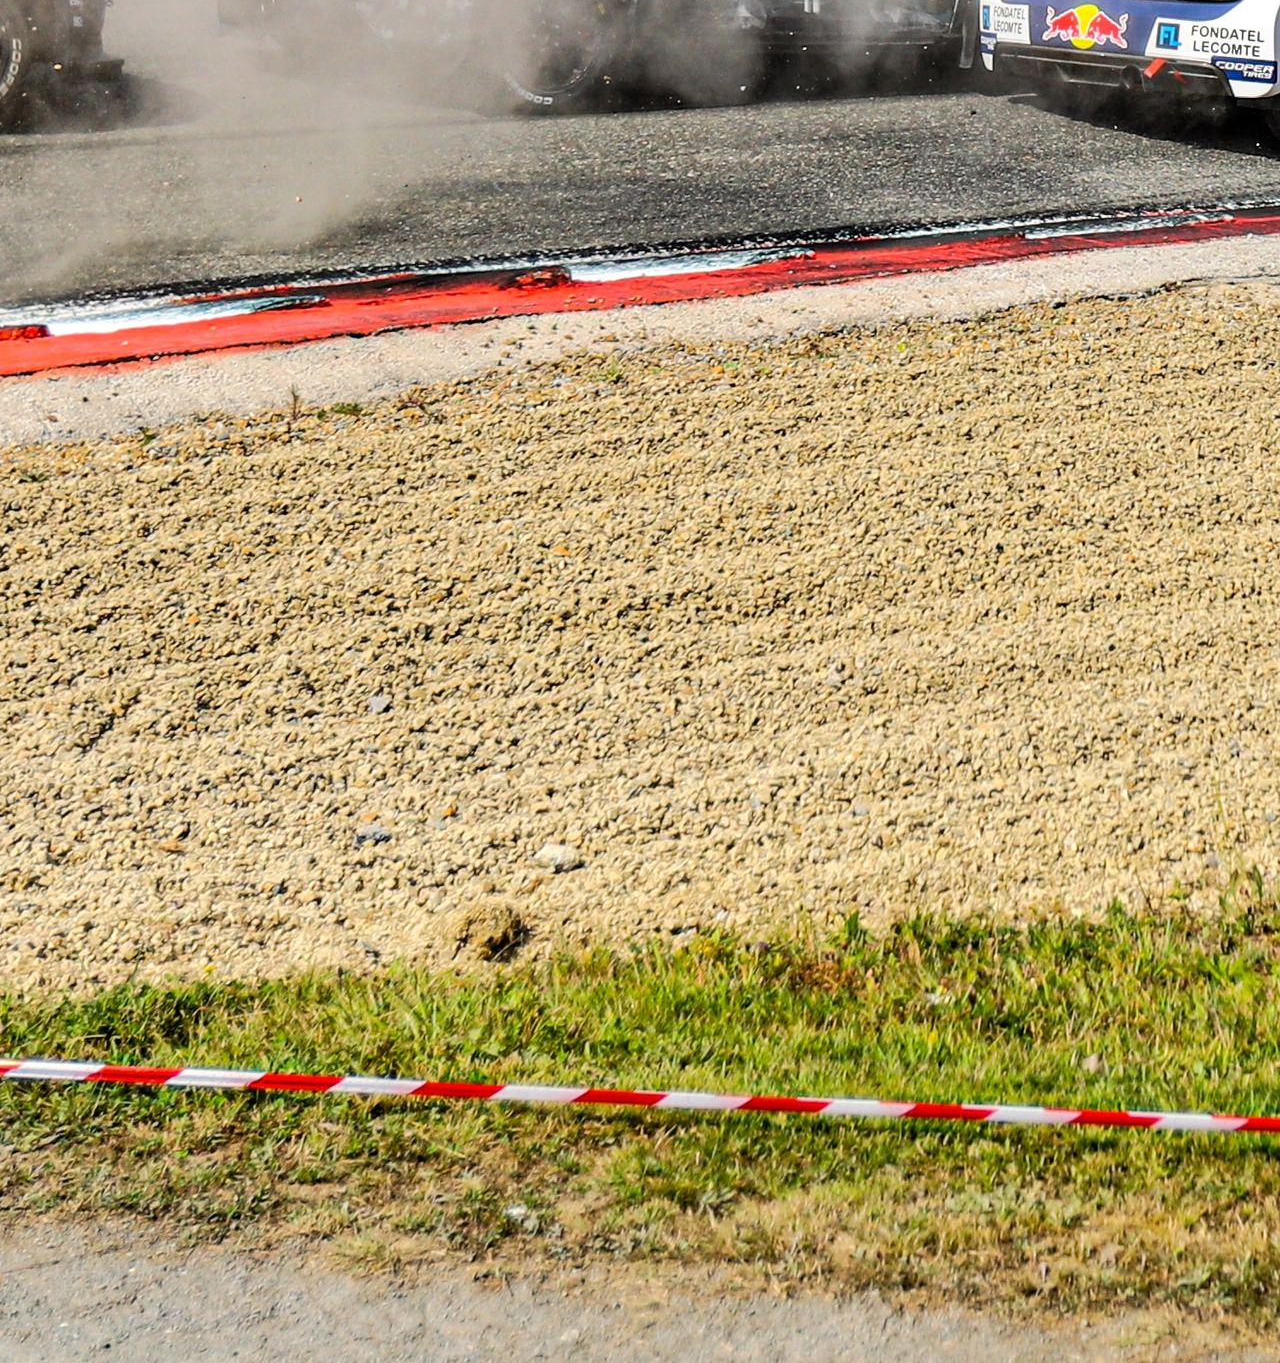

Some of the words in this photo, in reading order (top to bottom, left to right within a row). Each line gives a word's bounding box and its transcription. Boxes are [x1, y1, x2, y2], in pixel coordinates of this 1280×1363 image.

[993, 6, 1025, 20] FONDATEL
[994, 20, 1022, 34] LECOMTE
[1191, 25, 1265, 43] FONDATEL
[1193, 41, 1261, 57] LECOMTE
[1215, 60, 1275, 73] COOPER
[1243, 70, 1273, 79] TIRES
